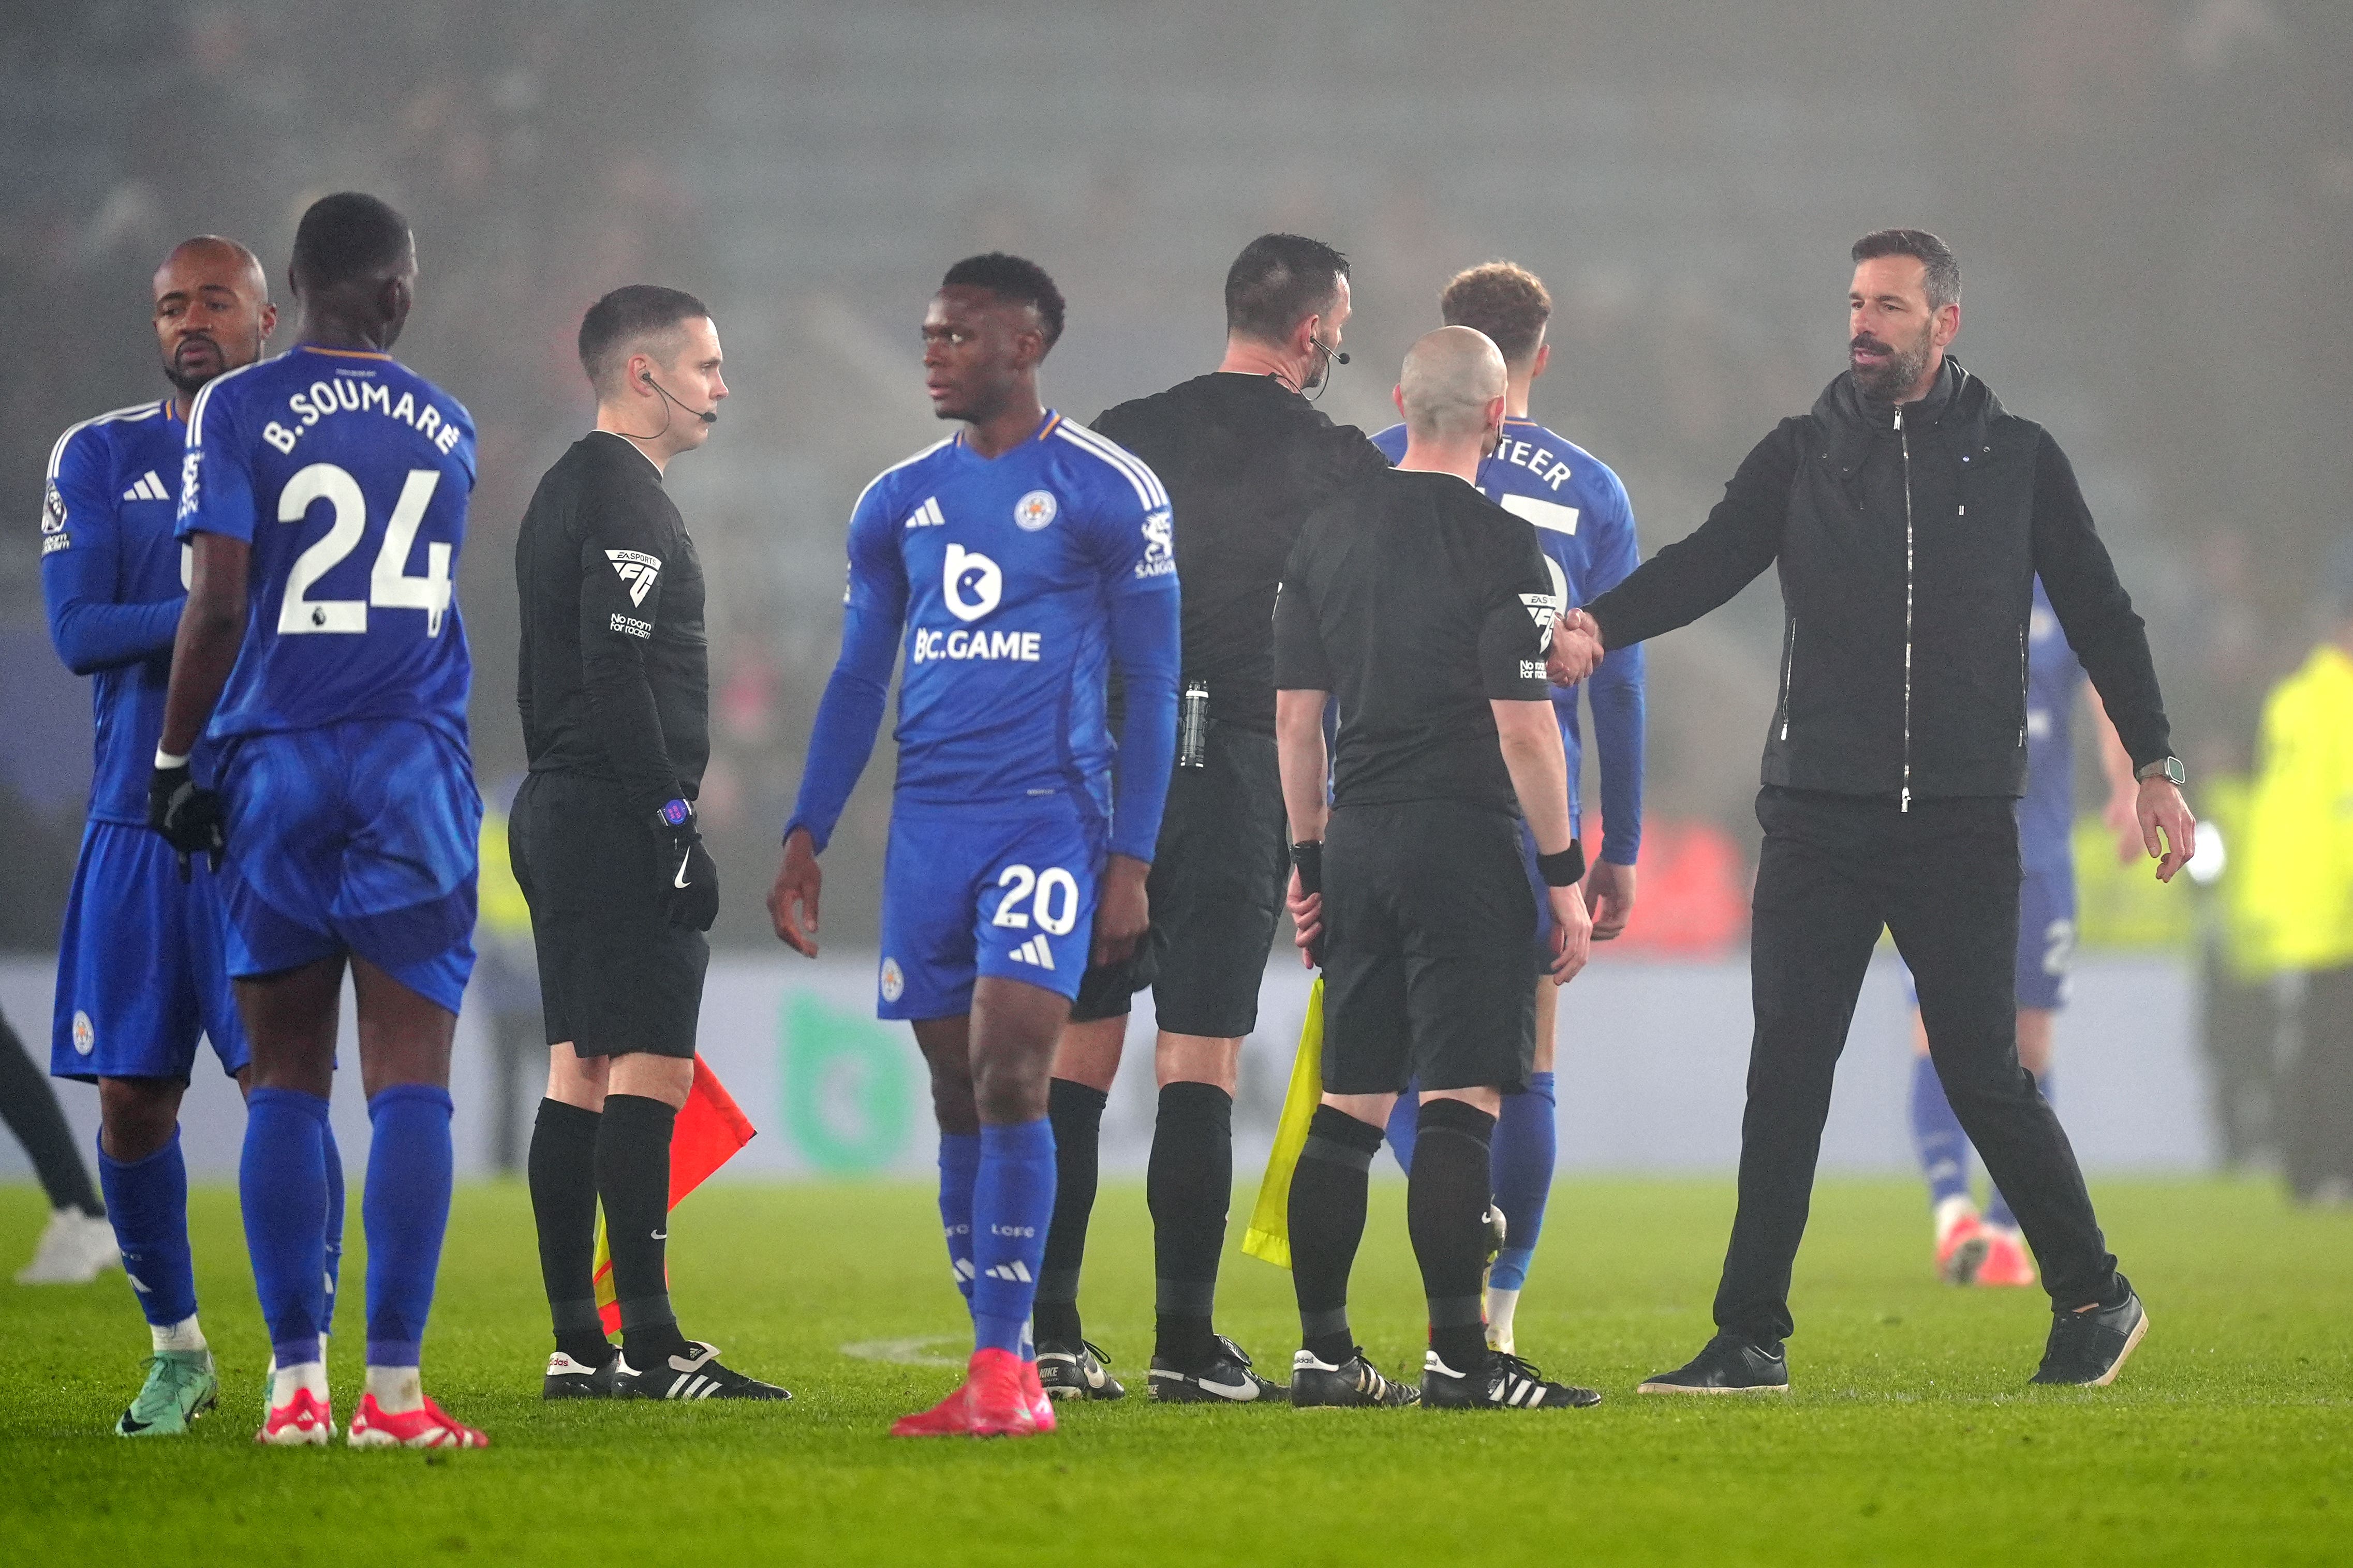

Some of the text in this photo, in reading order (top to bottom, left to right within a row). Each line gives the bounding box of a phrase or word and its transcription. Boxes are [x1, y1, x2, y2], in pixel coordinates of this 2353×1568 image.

[277, 462, 452, 637] 24
[610, 621, 651, 640] for racism
[611, 613, 652, 632] No room
[914, 627, 1042, 665] BC.GAME
[1520, 660, 1534, 670] No
[992, 863, 1079, 936] 20
[1039, 1366, 1059, 1379] NIKE
